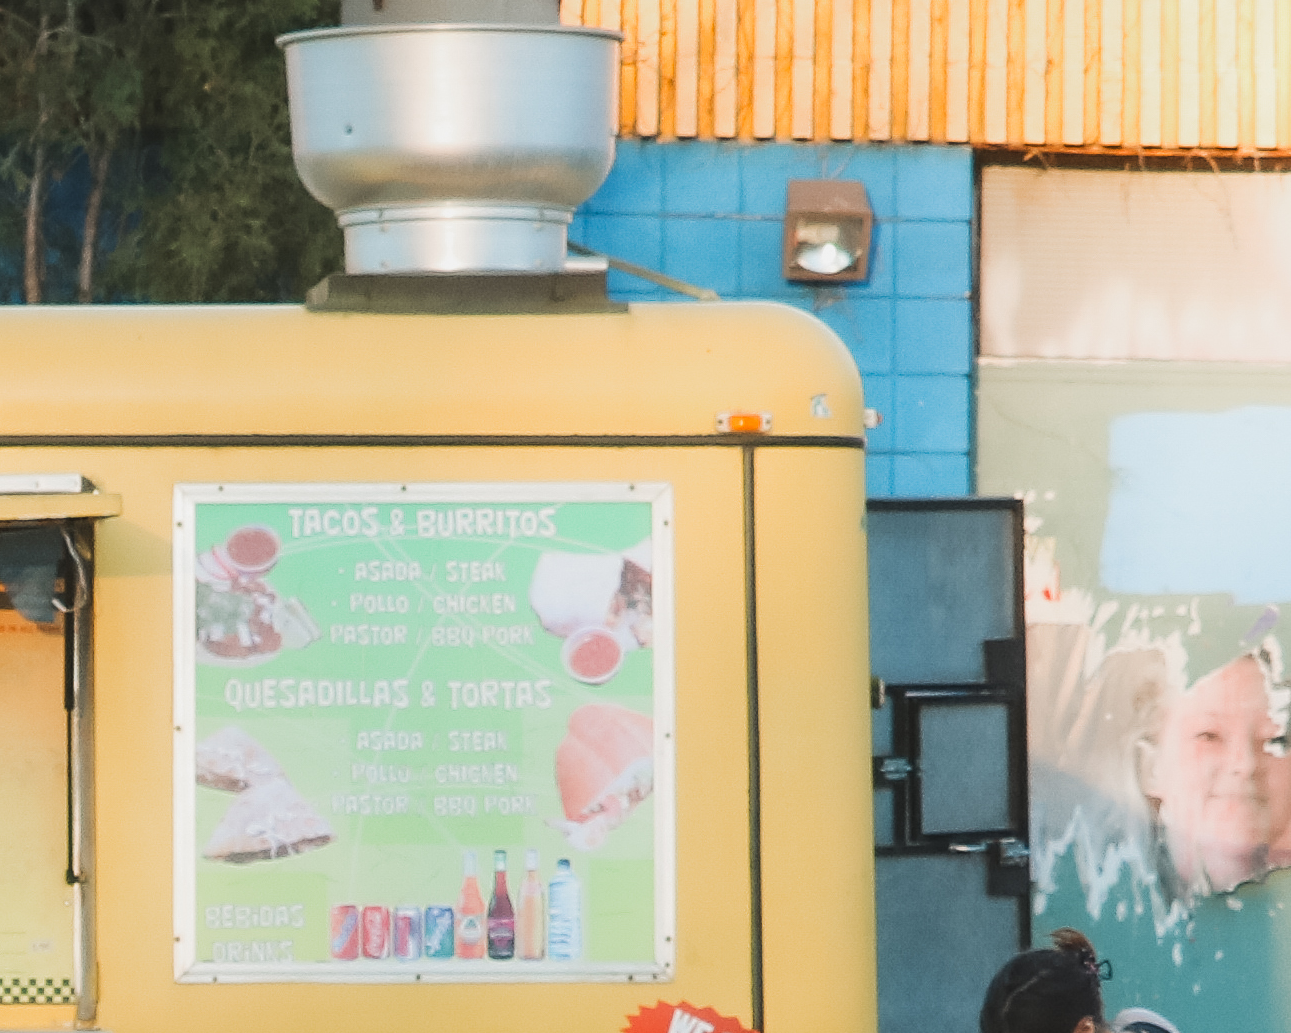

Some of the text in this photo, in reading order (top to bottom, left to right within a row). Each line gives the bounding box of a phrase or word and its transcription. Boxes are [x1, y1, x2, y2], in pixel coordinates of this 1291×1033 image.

[288, 508, 557, 537] TACOS & BURRITOS
[354, 561, 422, 582] ASADA
[446, 561, 506, 582] STEAK
[349, 594, 408, 615] POLLO
[432, 594, 516, 614] CHICKEN
[330, 625, 406, 646] PASTOR
[431, 625, 474, 647] BBQ
[482, 625, 535, 645] PORK
[224, 679, 553, 711] QUESADILLAS & TORTAS
[355, 730, 507, 751] ASADA STEAK
[350, 764, 518, 784] POLLO CHICKEN
[331, 794, 537, 818] PASTOR BBQ PORK
